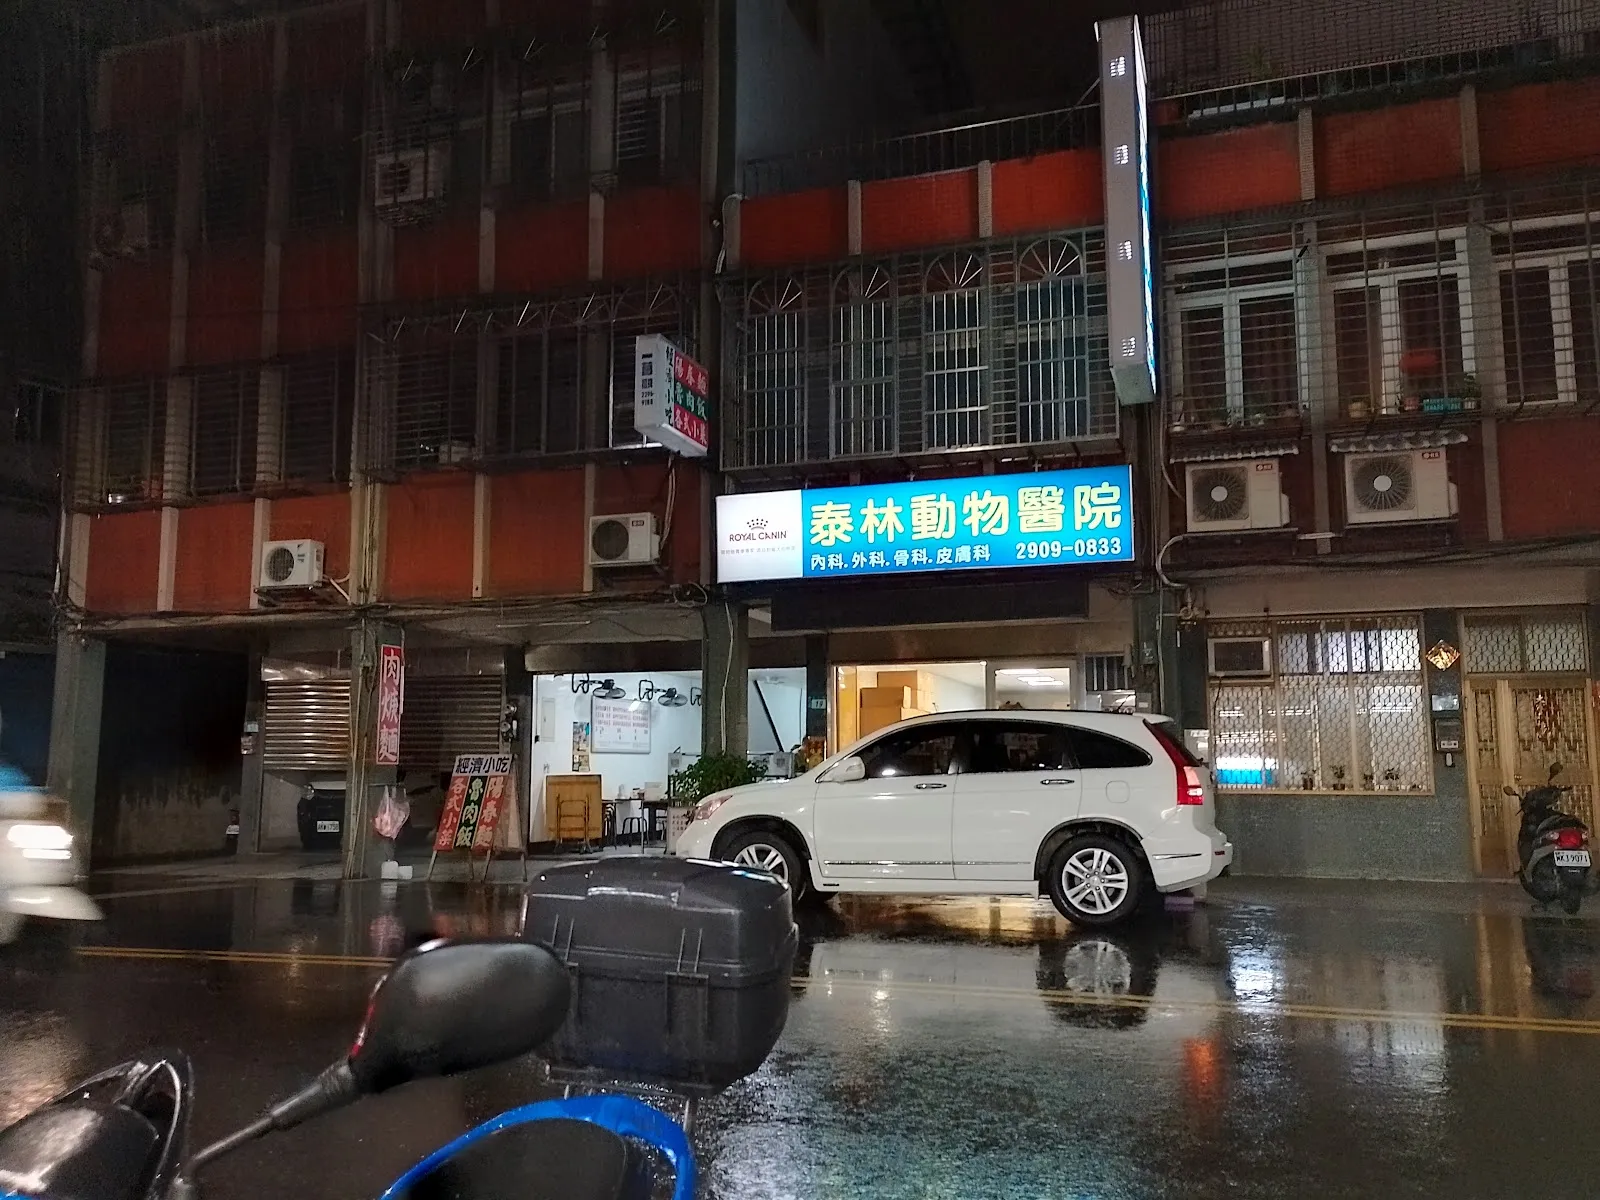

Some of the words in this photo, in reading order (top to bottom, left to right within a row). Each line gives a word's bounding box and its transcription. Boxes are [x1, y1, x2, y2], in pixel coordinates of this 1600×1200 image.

[729, 532, 757, 542] ROYAL
[758, 531, 787, 541] CANIN
[809, 481, 1122, 547] 泰林動物醫院
[1015, 536, 1122, 560] 2909-0833
[455, 756, 510, 774] 經濟小吃
[438, 777, 467, 846] 各式小菜
[455, 777, 484, 847] 魯肉飯
[475, 776, 505, 848] 陽春麵
